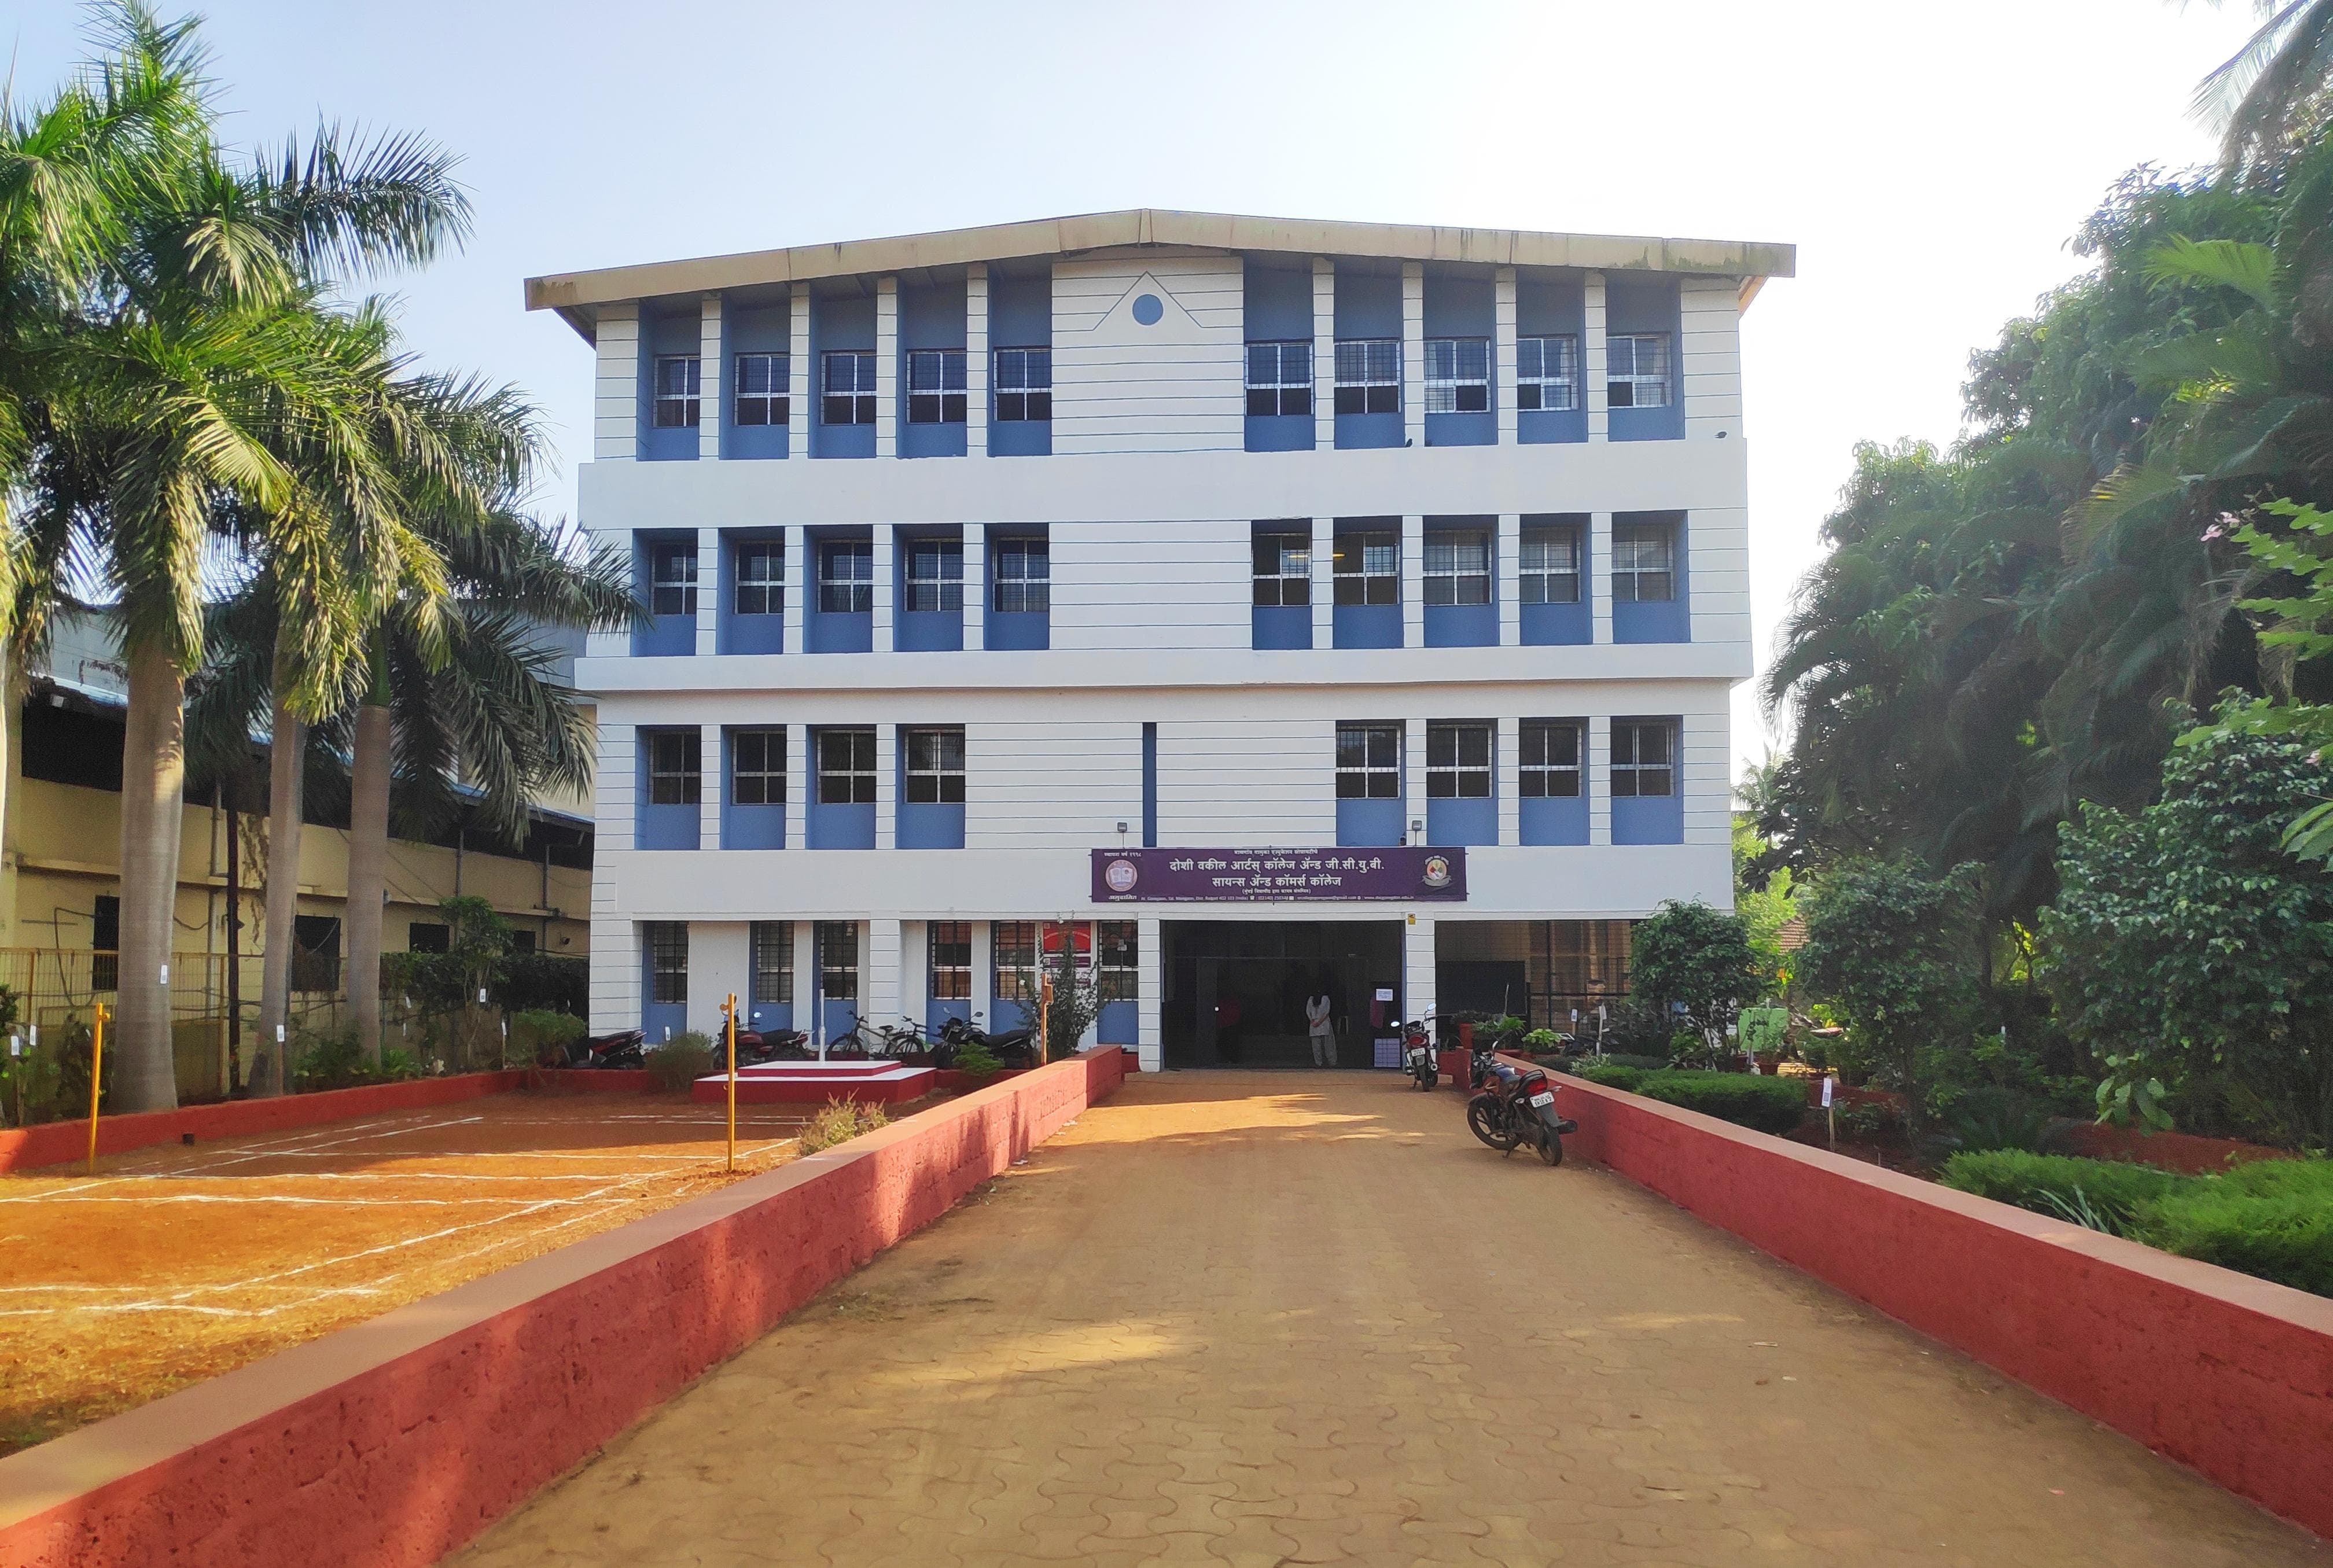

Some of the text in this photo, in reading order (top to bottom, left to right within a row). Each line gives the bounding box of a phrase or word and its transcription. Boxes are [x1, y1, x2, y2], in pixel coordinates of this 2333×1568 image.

[1169, 858, 1194, 871] दोशी
[1197, 858, 1227, 870] वकील
[1231, 858, 1261, 873] आर्टस्
[1264, 857, 1296, 870] कॉलेज
[1212, 877, 1246, 887] सायन्स
[1275, 874, 1306, 886] कॉमर्स
[1309, 874, 1342, 886] कॉलेज
